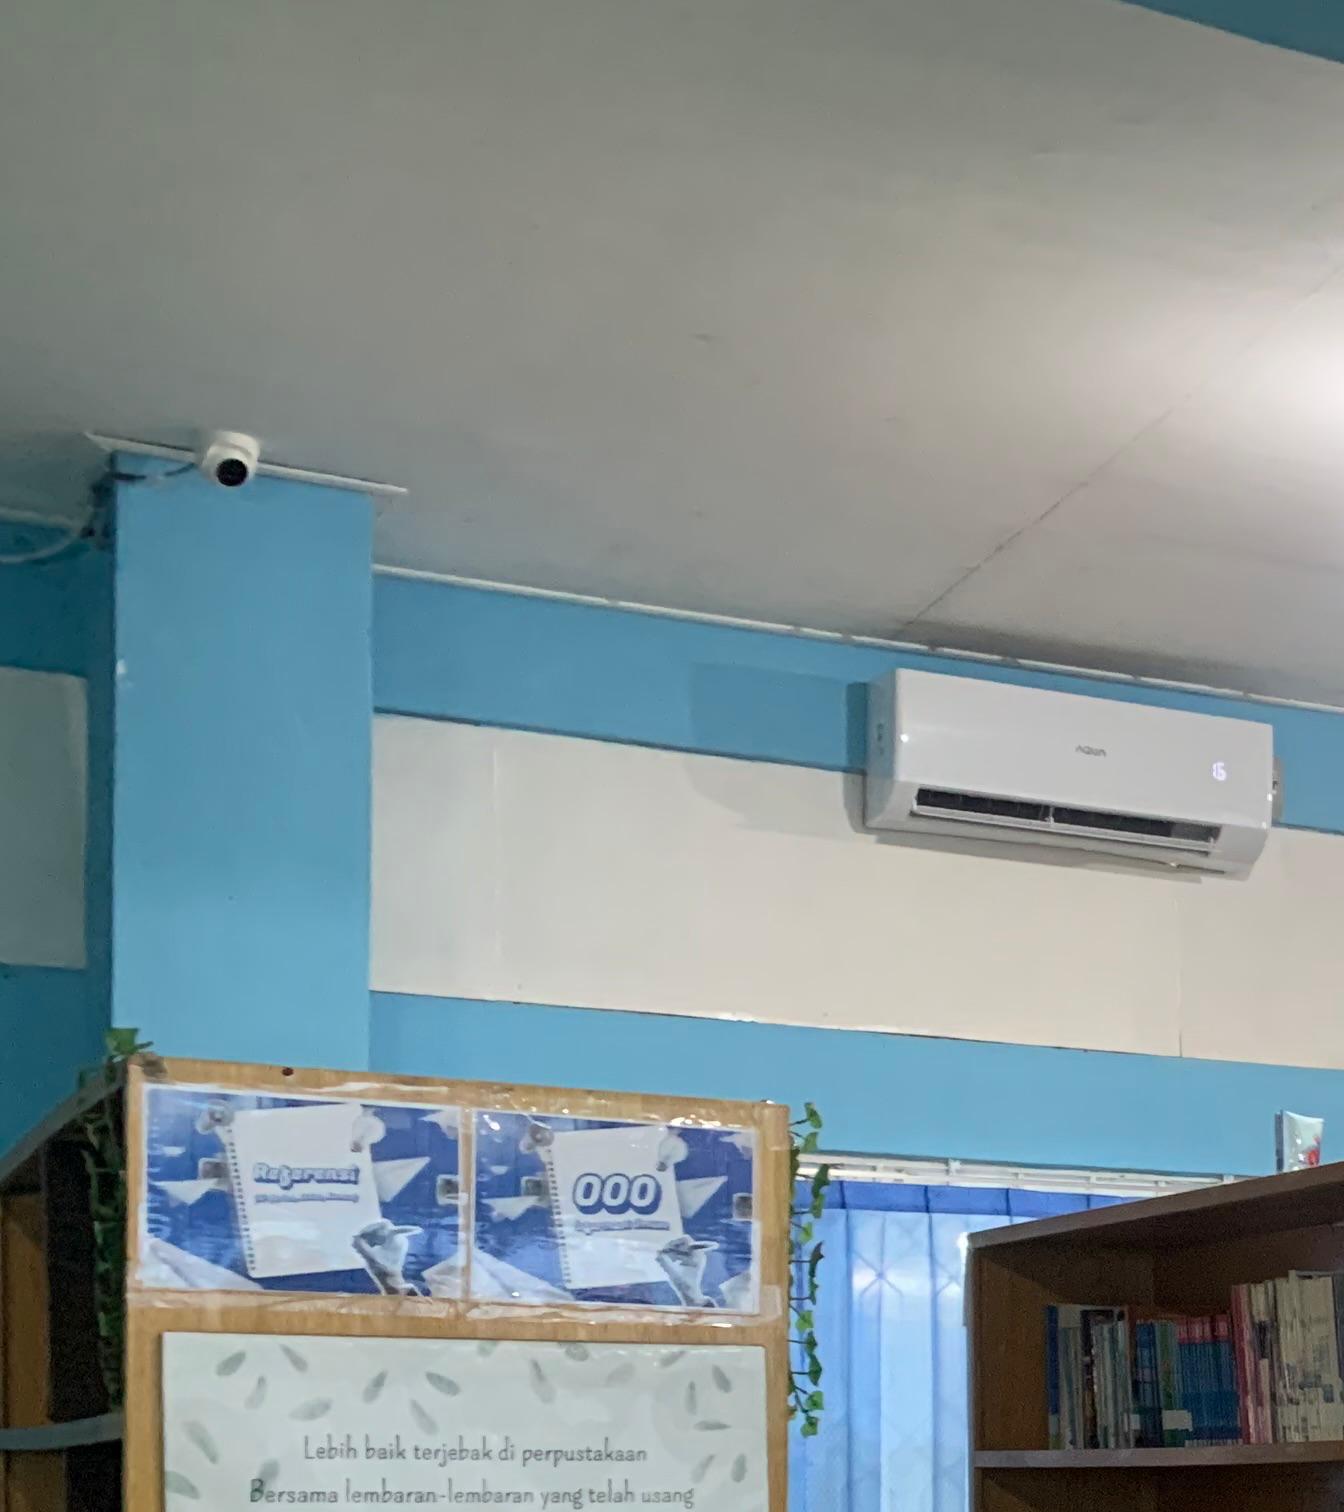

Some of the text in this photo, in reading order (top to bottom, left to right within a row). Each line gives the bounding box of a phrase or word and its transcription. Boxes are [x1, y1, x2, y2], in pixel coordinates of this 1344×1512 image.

[573, 1173, 663, 1215] 000
[304, 1433, 648, 1468] Lebih baik terjebak di perpustakaan
[250, 1477, 695, 1510] Bersama lembaran-lembaran yang telah usang
